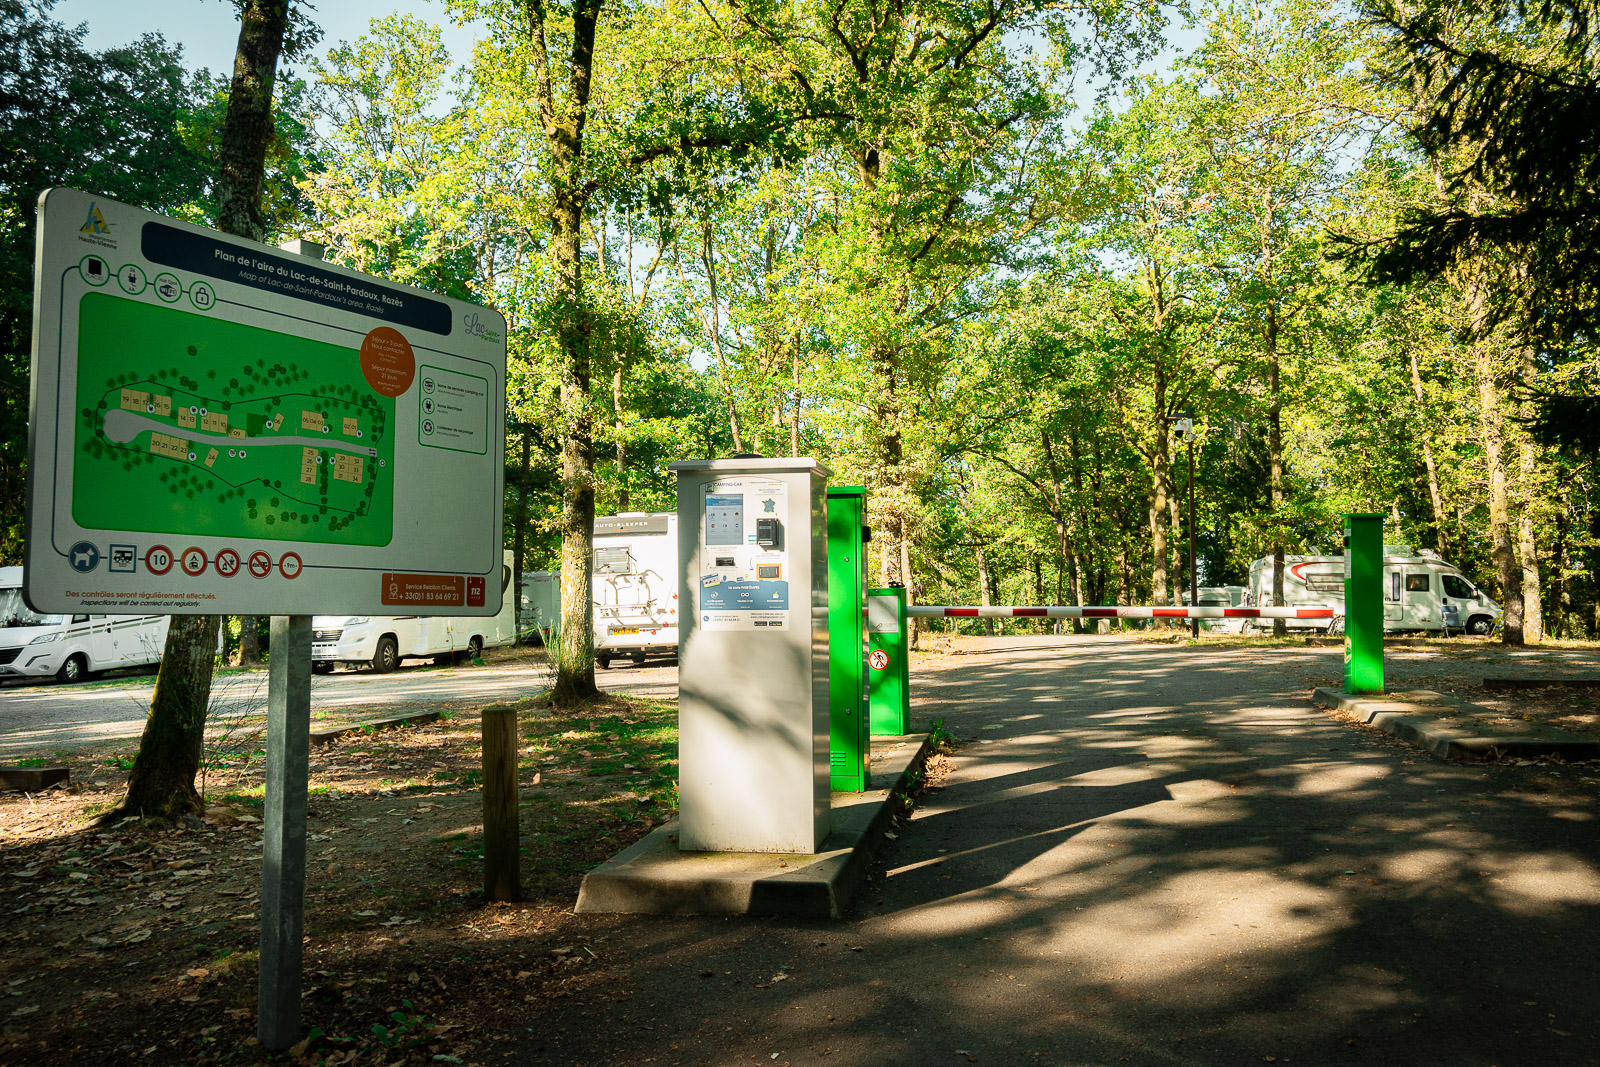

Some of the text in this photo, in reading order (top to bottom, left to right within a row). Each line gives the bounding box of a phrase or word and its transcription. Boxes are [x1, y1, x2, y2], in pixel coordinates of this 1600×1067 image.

[78, 236, 117, 249] Haute-Vienne
[214, 249, 403, 308] Plan de l'aire du Lac-de-Saint-Pardoux, Razès
[238, 270, 257, 281] Map
[347, 299, 364, 309] area,
[366, 303, 384, 314] Razès
[464, 312, 485, 336] Lac
[153, 554, 167, 566] 10
[139, 592, 184, 600] régulièrement
[405, 592, 424, 600] 33(0)1
